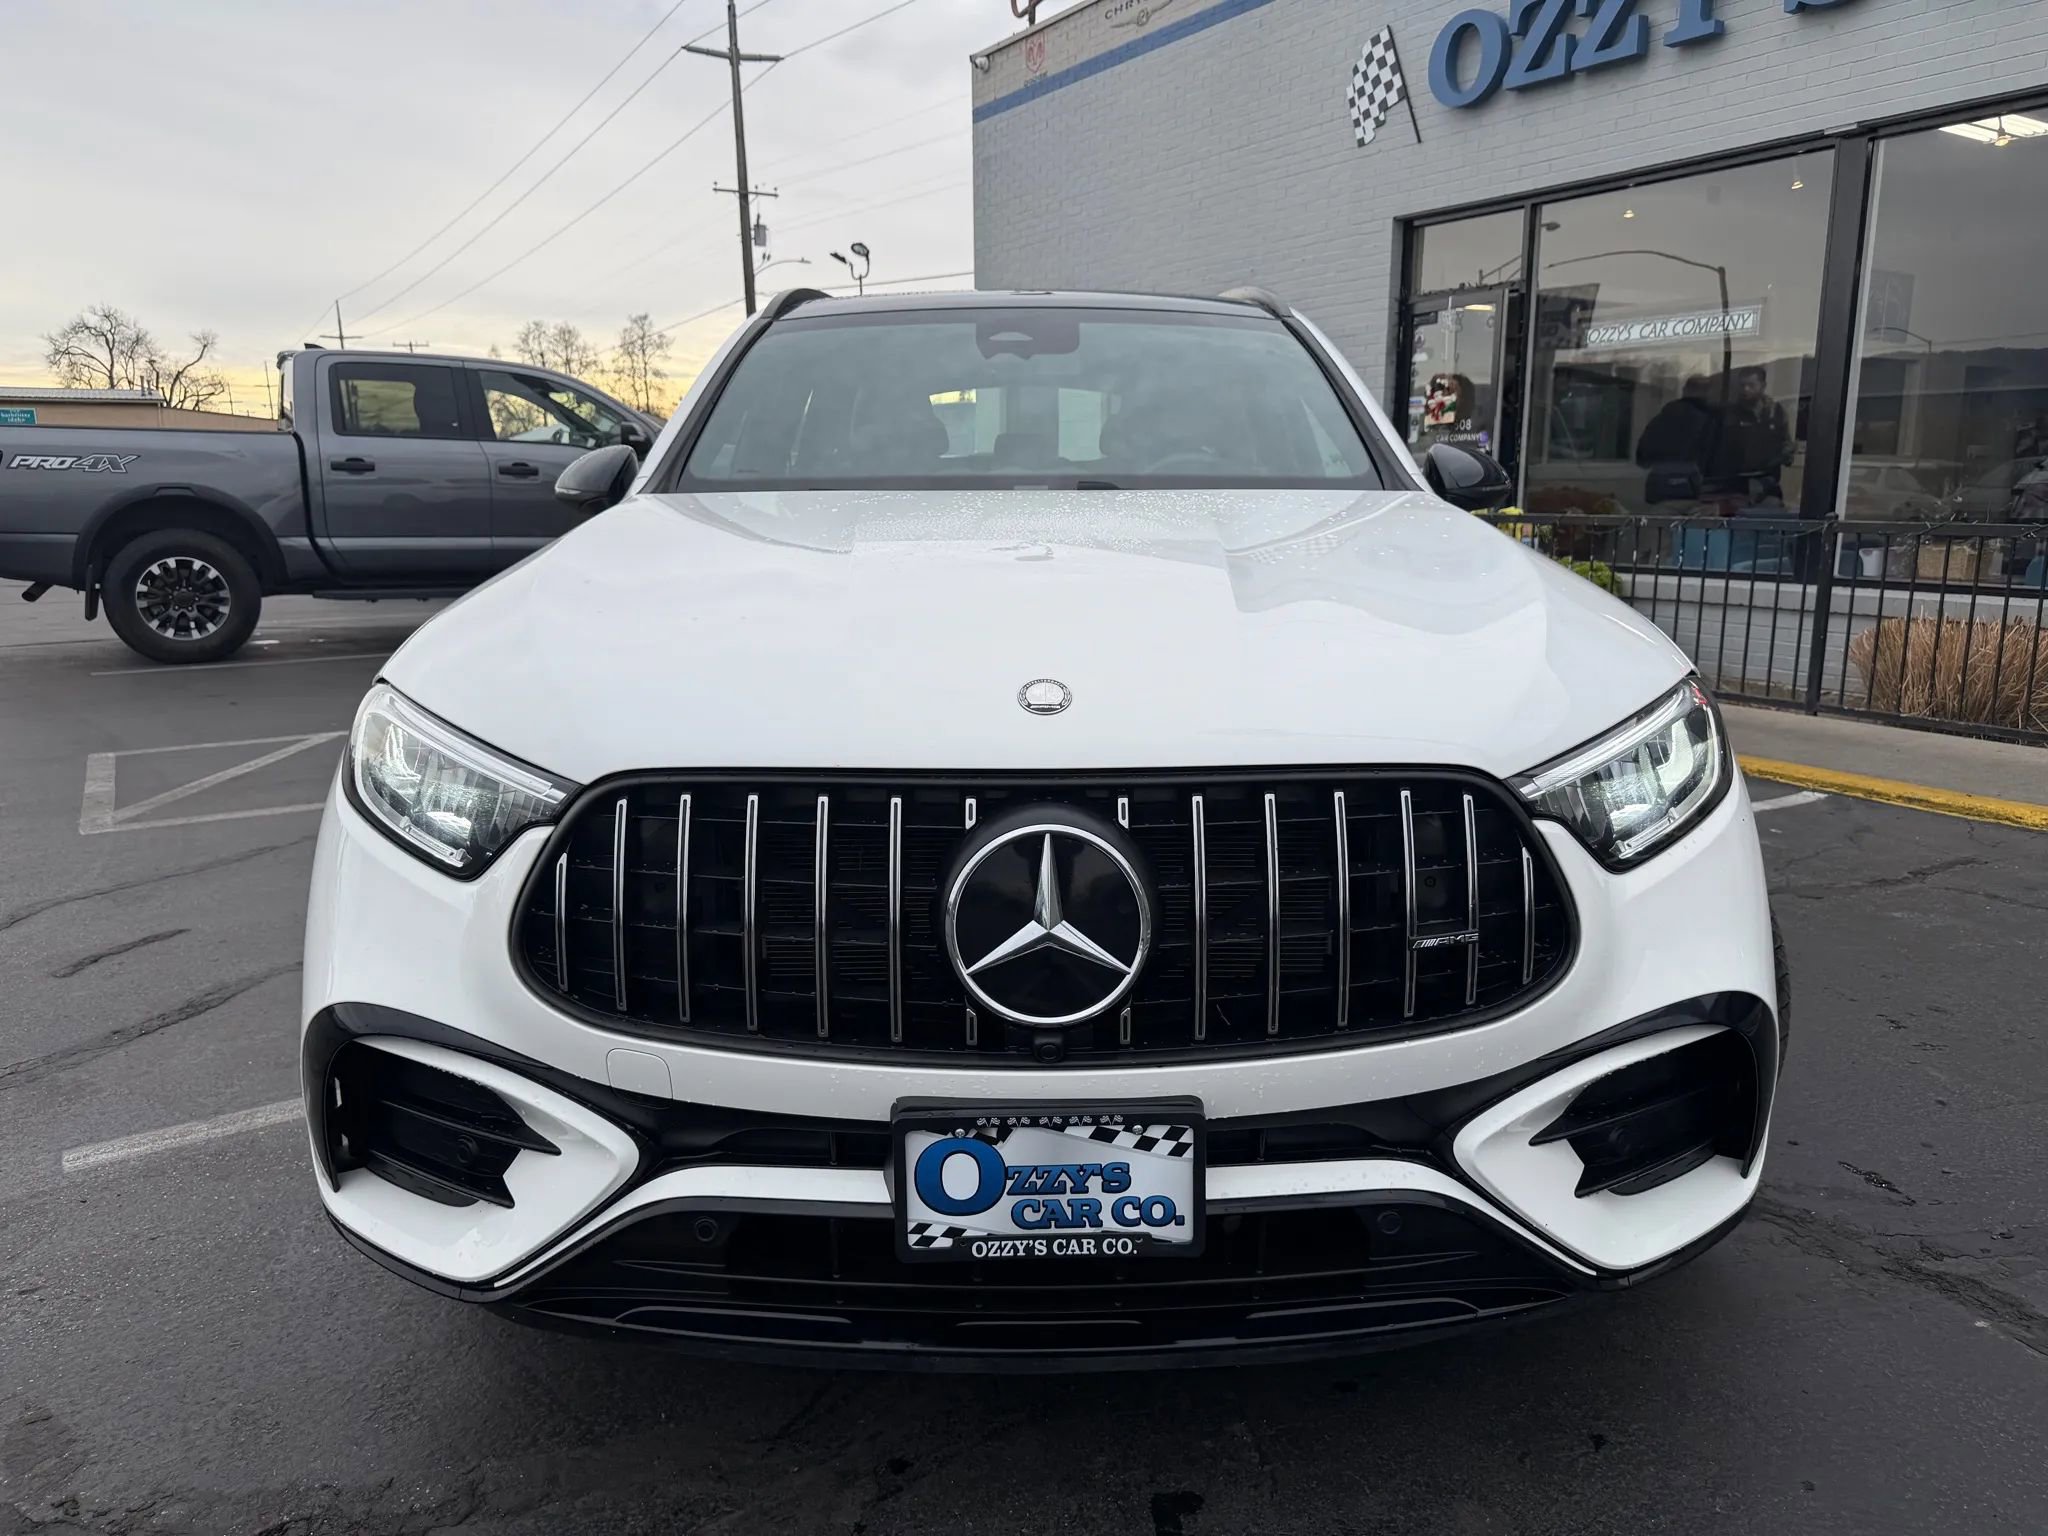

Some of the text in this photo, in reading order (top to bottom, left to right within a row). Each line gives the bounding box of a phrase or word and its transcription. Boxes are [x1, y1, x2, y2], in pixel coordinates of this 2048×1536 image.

[1588, 311, 1752, 344] OZZY'S CAR COMPANY
[1433, 932, 1479, 946] AMG
[914, 1136, 1131, 1216] OZZY'S
[1011, 1194, 1185, 1230] CAR CO.
[971, 1237, 1138, 1258] OZZY'S CAR CO.
